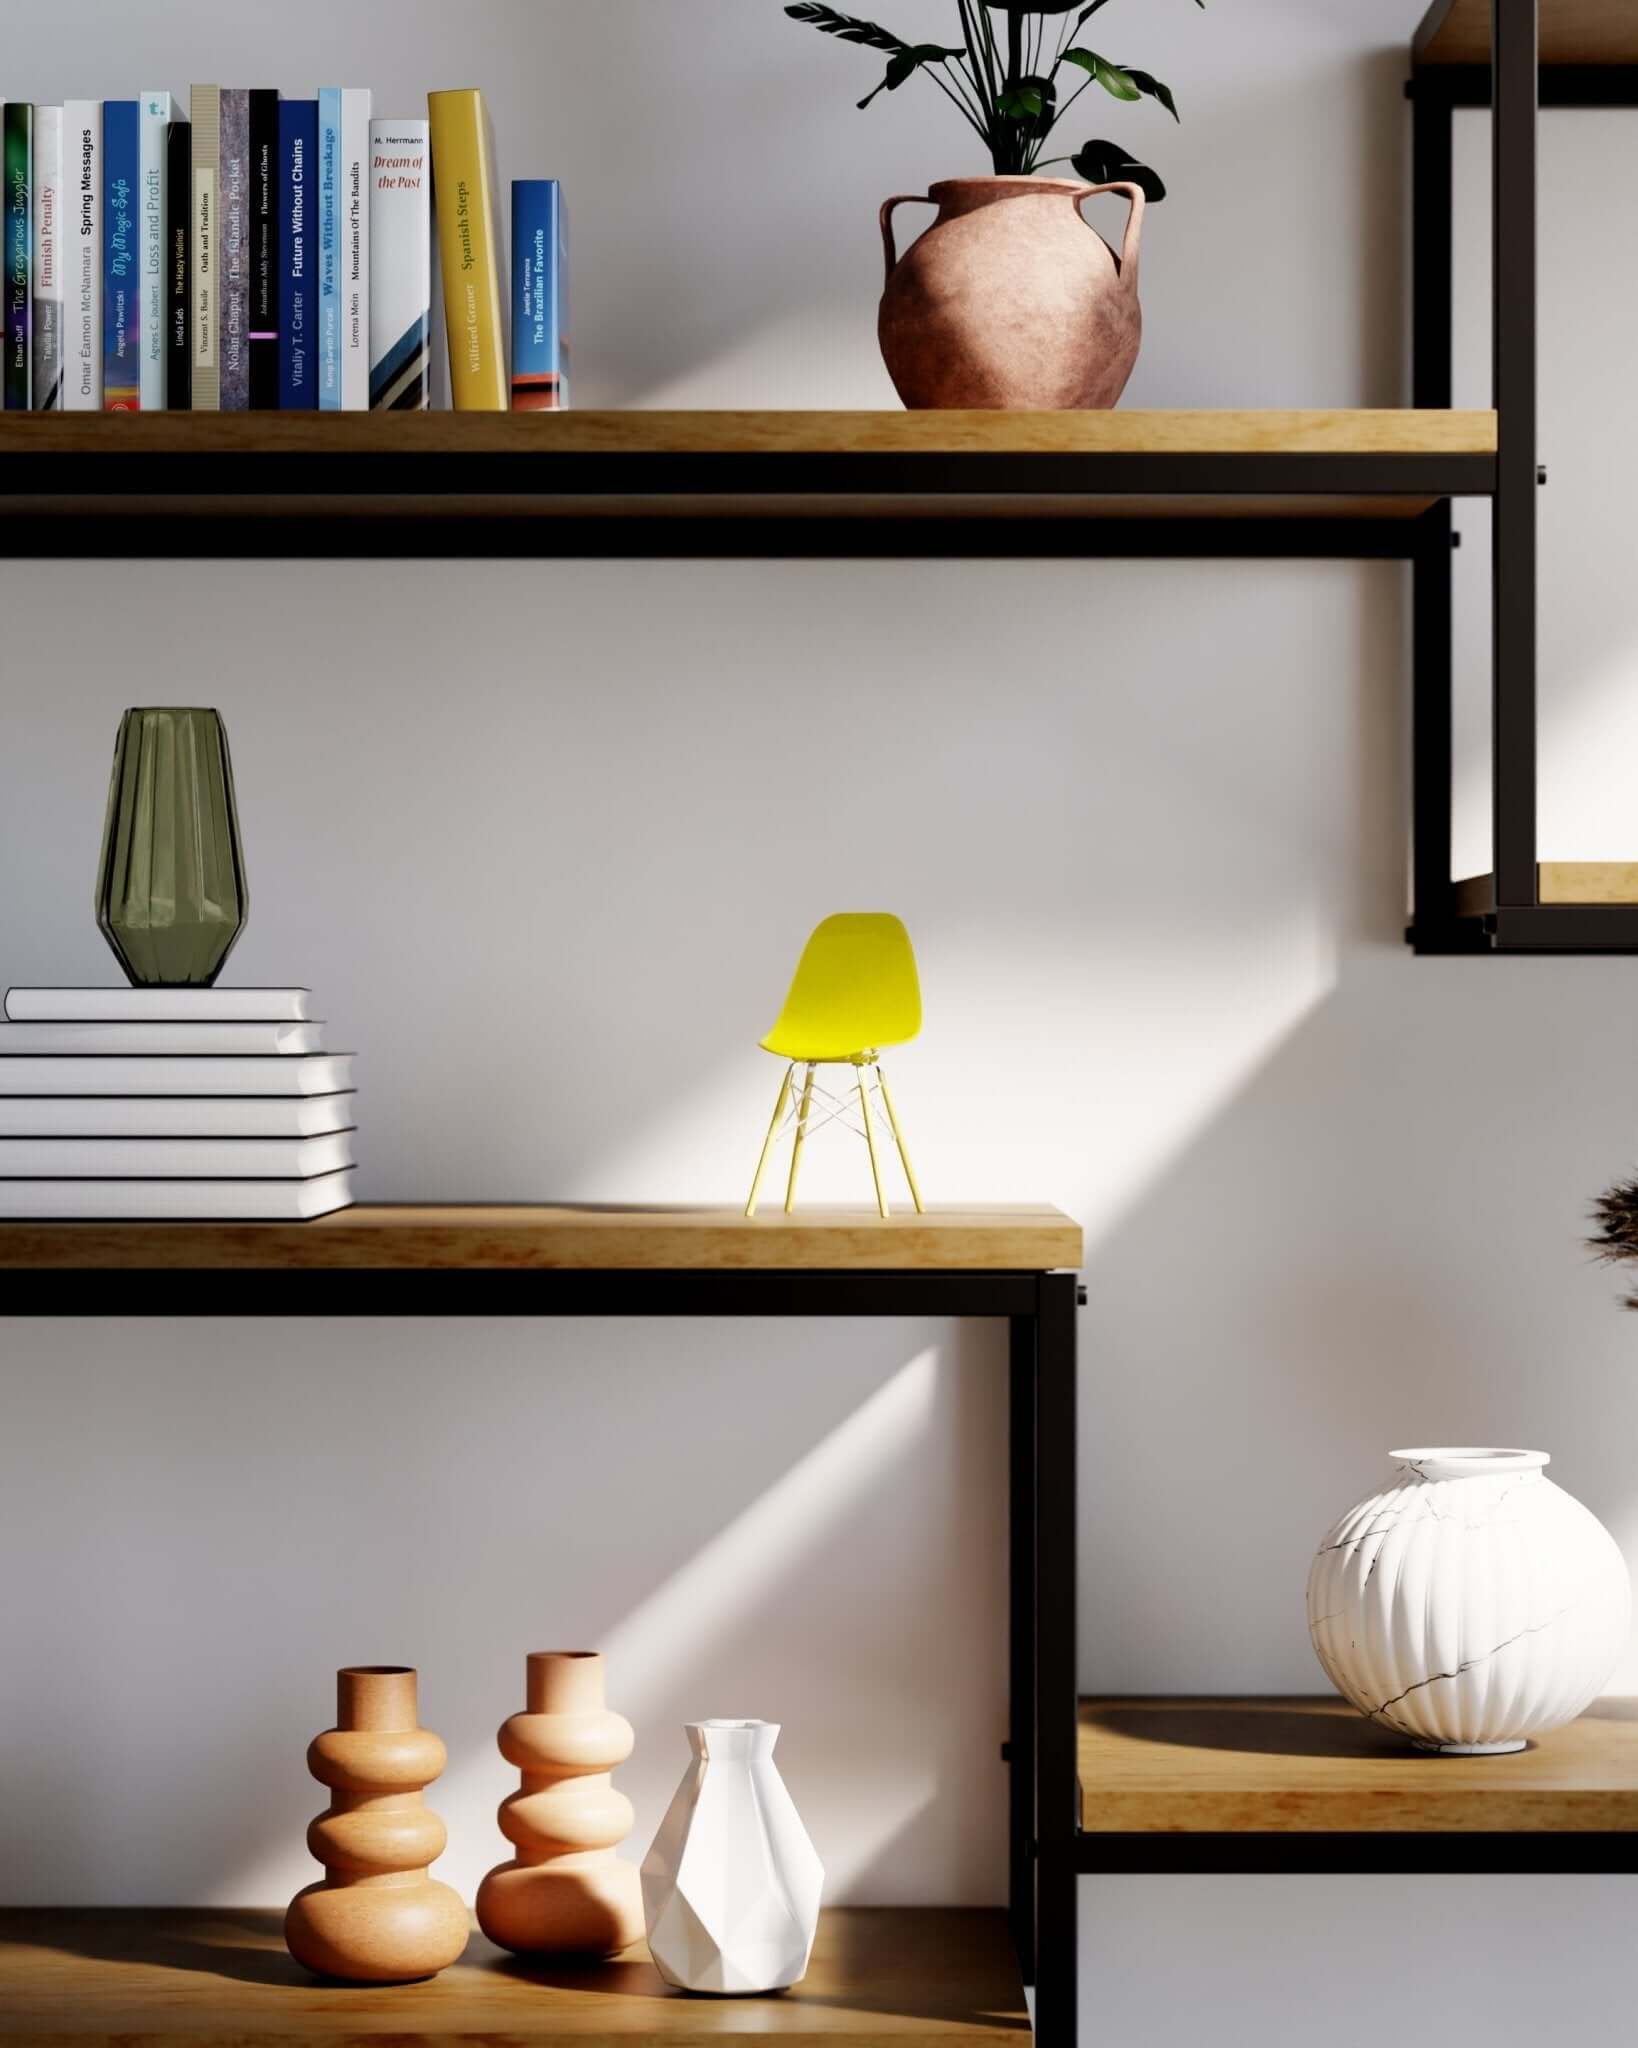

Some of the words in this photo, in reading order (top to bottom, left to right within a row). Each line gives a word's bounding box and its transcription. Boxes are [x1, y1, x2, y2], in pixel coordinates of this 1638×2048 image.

[374, 136, 382, 144] M.
[386, 136, 424, 144] Herrmann
[81, 129, 94, 192] Messages
[292, 138, 303, 181] Chains
[323, 128, 335, 190] Breakage
[374, 156, 410, 168] Dream
[412, 156, 422, 170] of
[12, 168, 28, 215] Juggler
[112, 179, 130, 208] Sofa
[146, 169, 159, 210] Profit
[229, 159, 240, 200] Pocket
[261, 172, 268, 182] of
[351, 162, 360, 196] Bandits
[378, 176, 396, 188] the
[398, 176, 421, 188] Past
[41, 186, 54, 235] Penalty
[80, 194, 94, 236] Spring
[292, 184, 303, 234] Without
[351, 200, 360, 216] The
[456, 181, 470, 216] Steps
[111, 211, 132, 250] Magic
[146, 216, 159, 240] and
[229, 206, 240, 254] Islandic
[323, 195, 334, 249] Without
[351, 218, 360, 229] Of
[12, 218, 28, 285] Gregarious
[146, 244, 159, 274] Loss
[292, 238, 303, 278] Future
[351, 231, 360, 280] Mountains
[458, 219, 474, 270] Spanish
[534, 229, 544, 272] Favorite
[41, 239, 52, 288] Finnish
[80, 246, 92, 312] McNamara
[111, 252, 132, 276] My
[176, 260, 186, 280] Hasty
[229, 258, 240, 280] The
[260, 260, 269, 277] Addy
[323, 254, 334, 296] Waves
[12, 289, 24, 314] The
[150, 285, 159, 318] Joubert
[229, 292, 242, 334] Chaput
[292, 291, 303, 330] Carter
[350, 293, 359, 316] Mein
[534, 276, 544, 321] Brazilian
[176, 308, 184, 324] Eads
[350, 318, 359, 348] Lorena
[78, 315, 92, 358] Éamon
[116, 330, 126, 358] Angela
[150, 331, 160, 360] Agnes
[176, 326, 184, 346] Linda
[200, 324, 208, 353] Vinzent
[292, 333, 303, 344] T.
[468, 326, 480, 372] Wilfried
[534, 324, 544, 344] The
[229, 337, 240, 370] Nolan
[292, 348, 306, 386] Vitaliy
[80, 362, 92, 395] Omar
